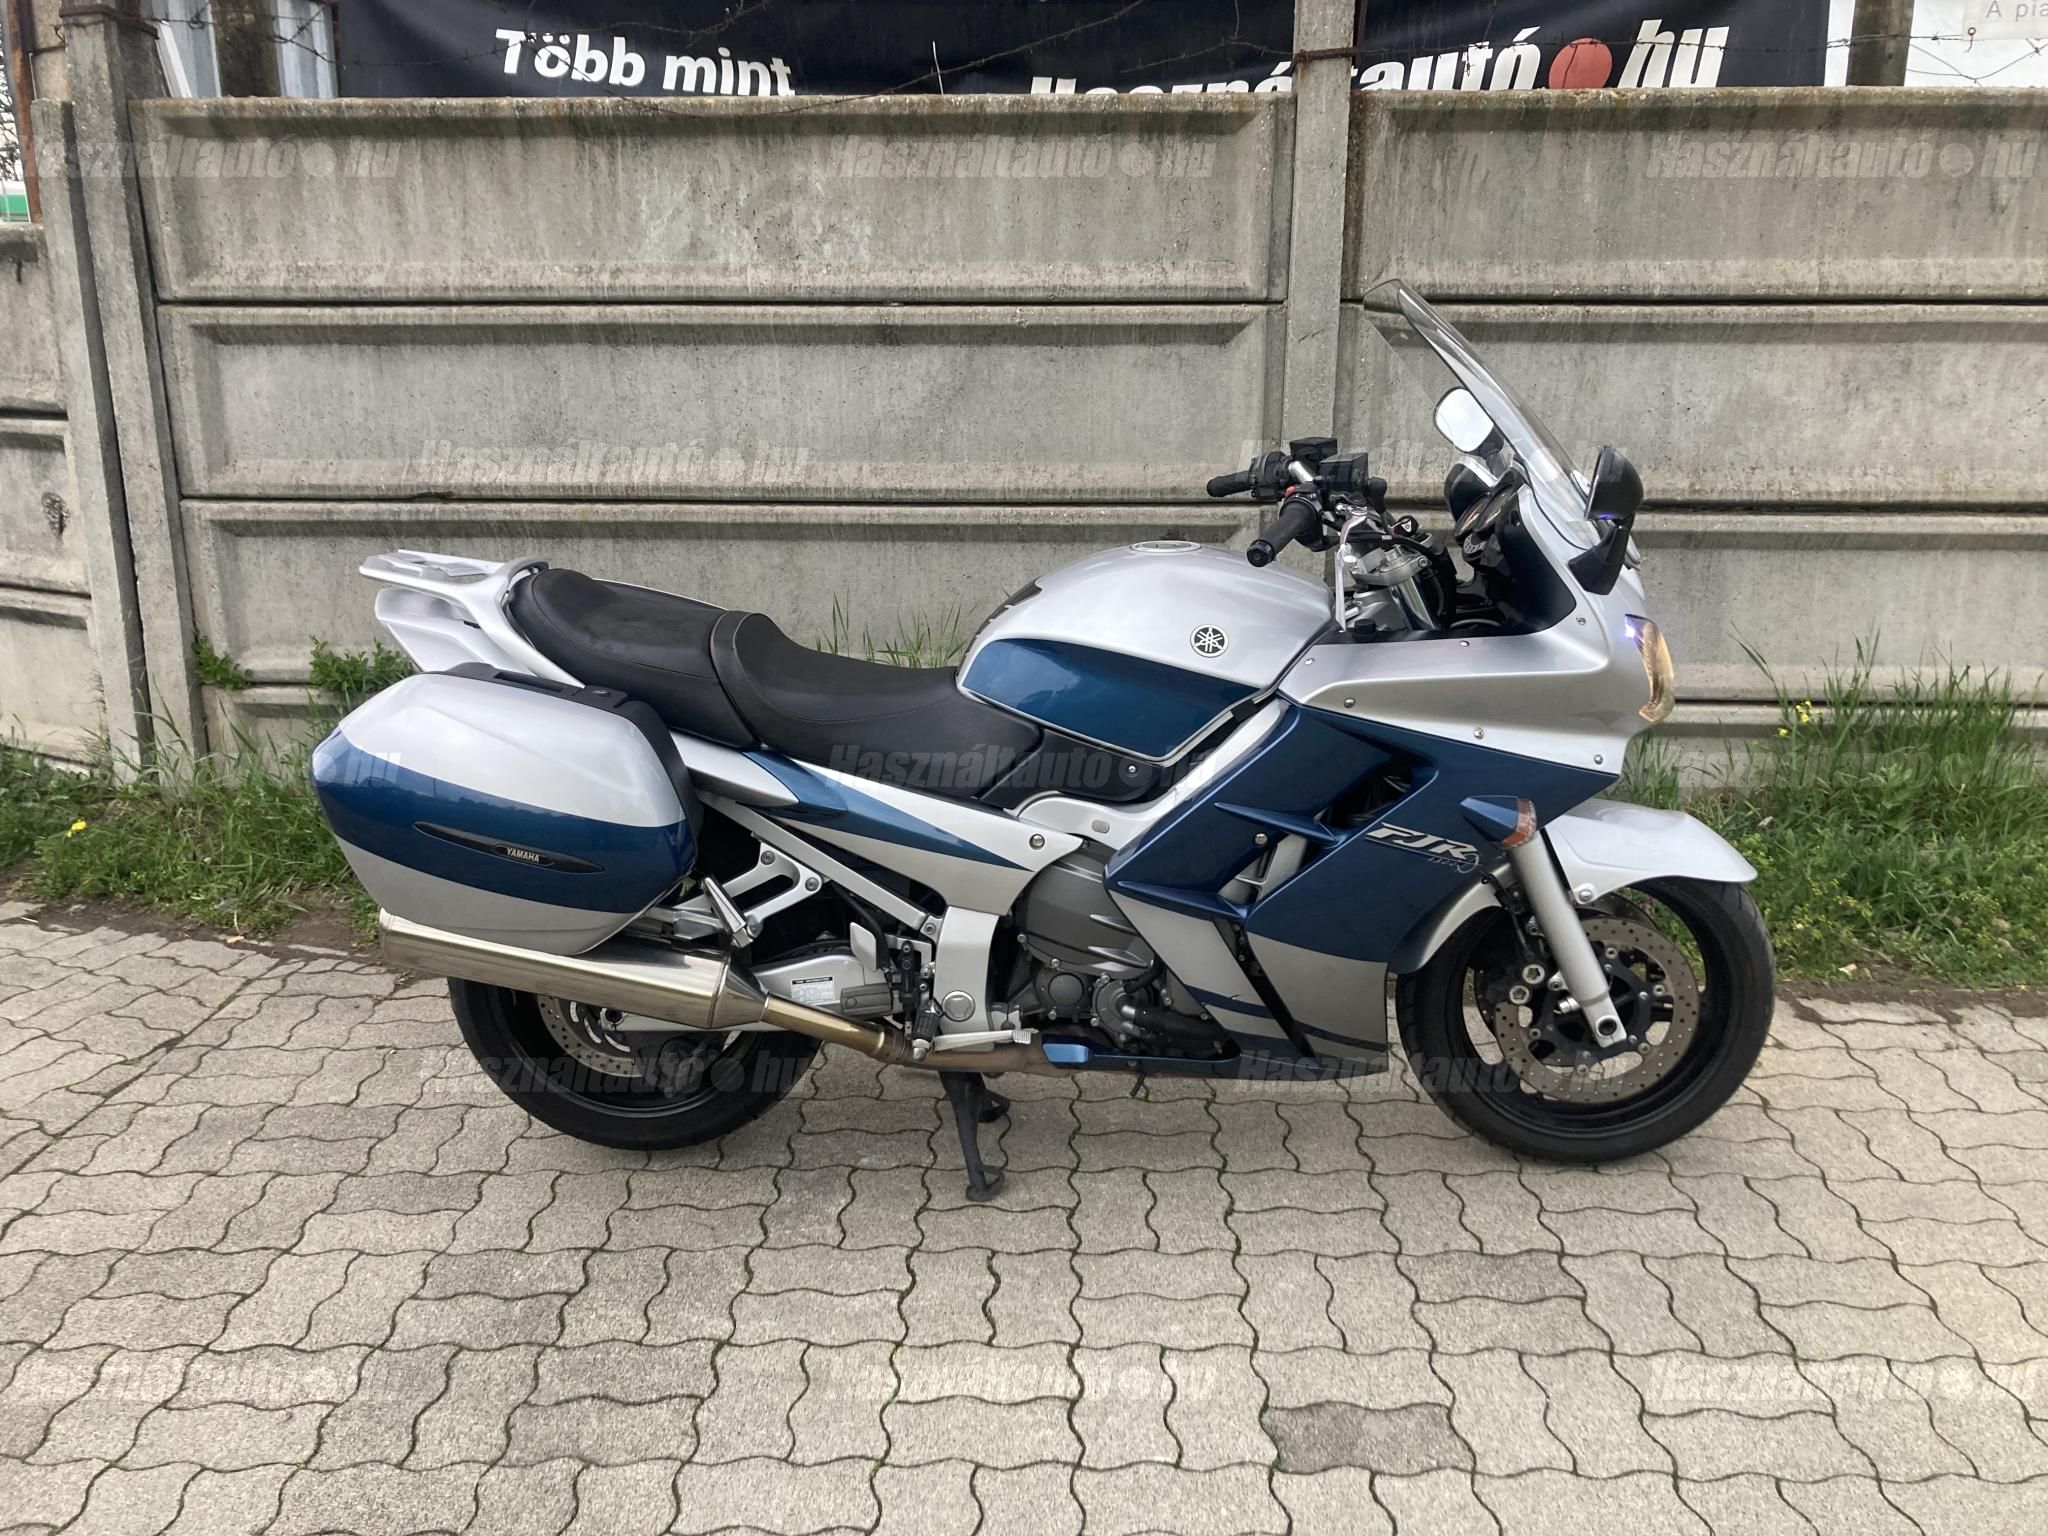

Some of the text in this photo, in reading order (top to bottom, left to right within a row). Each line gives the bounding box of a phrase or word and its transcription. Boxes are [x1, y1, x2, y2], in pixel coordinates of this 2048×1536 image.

[496, 29, 796, 96] Több mint
[507, 847, 540, 862] YAMAHA
[1366, 821, 1479, 860] FJR
